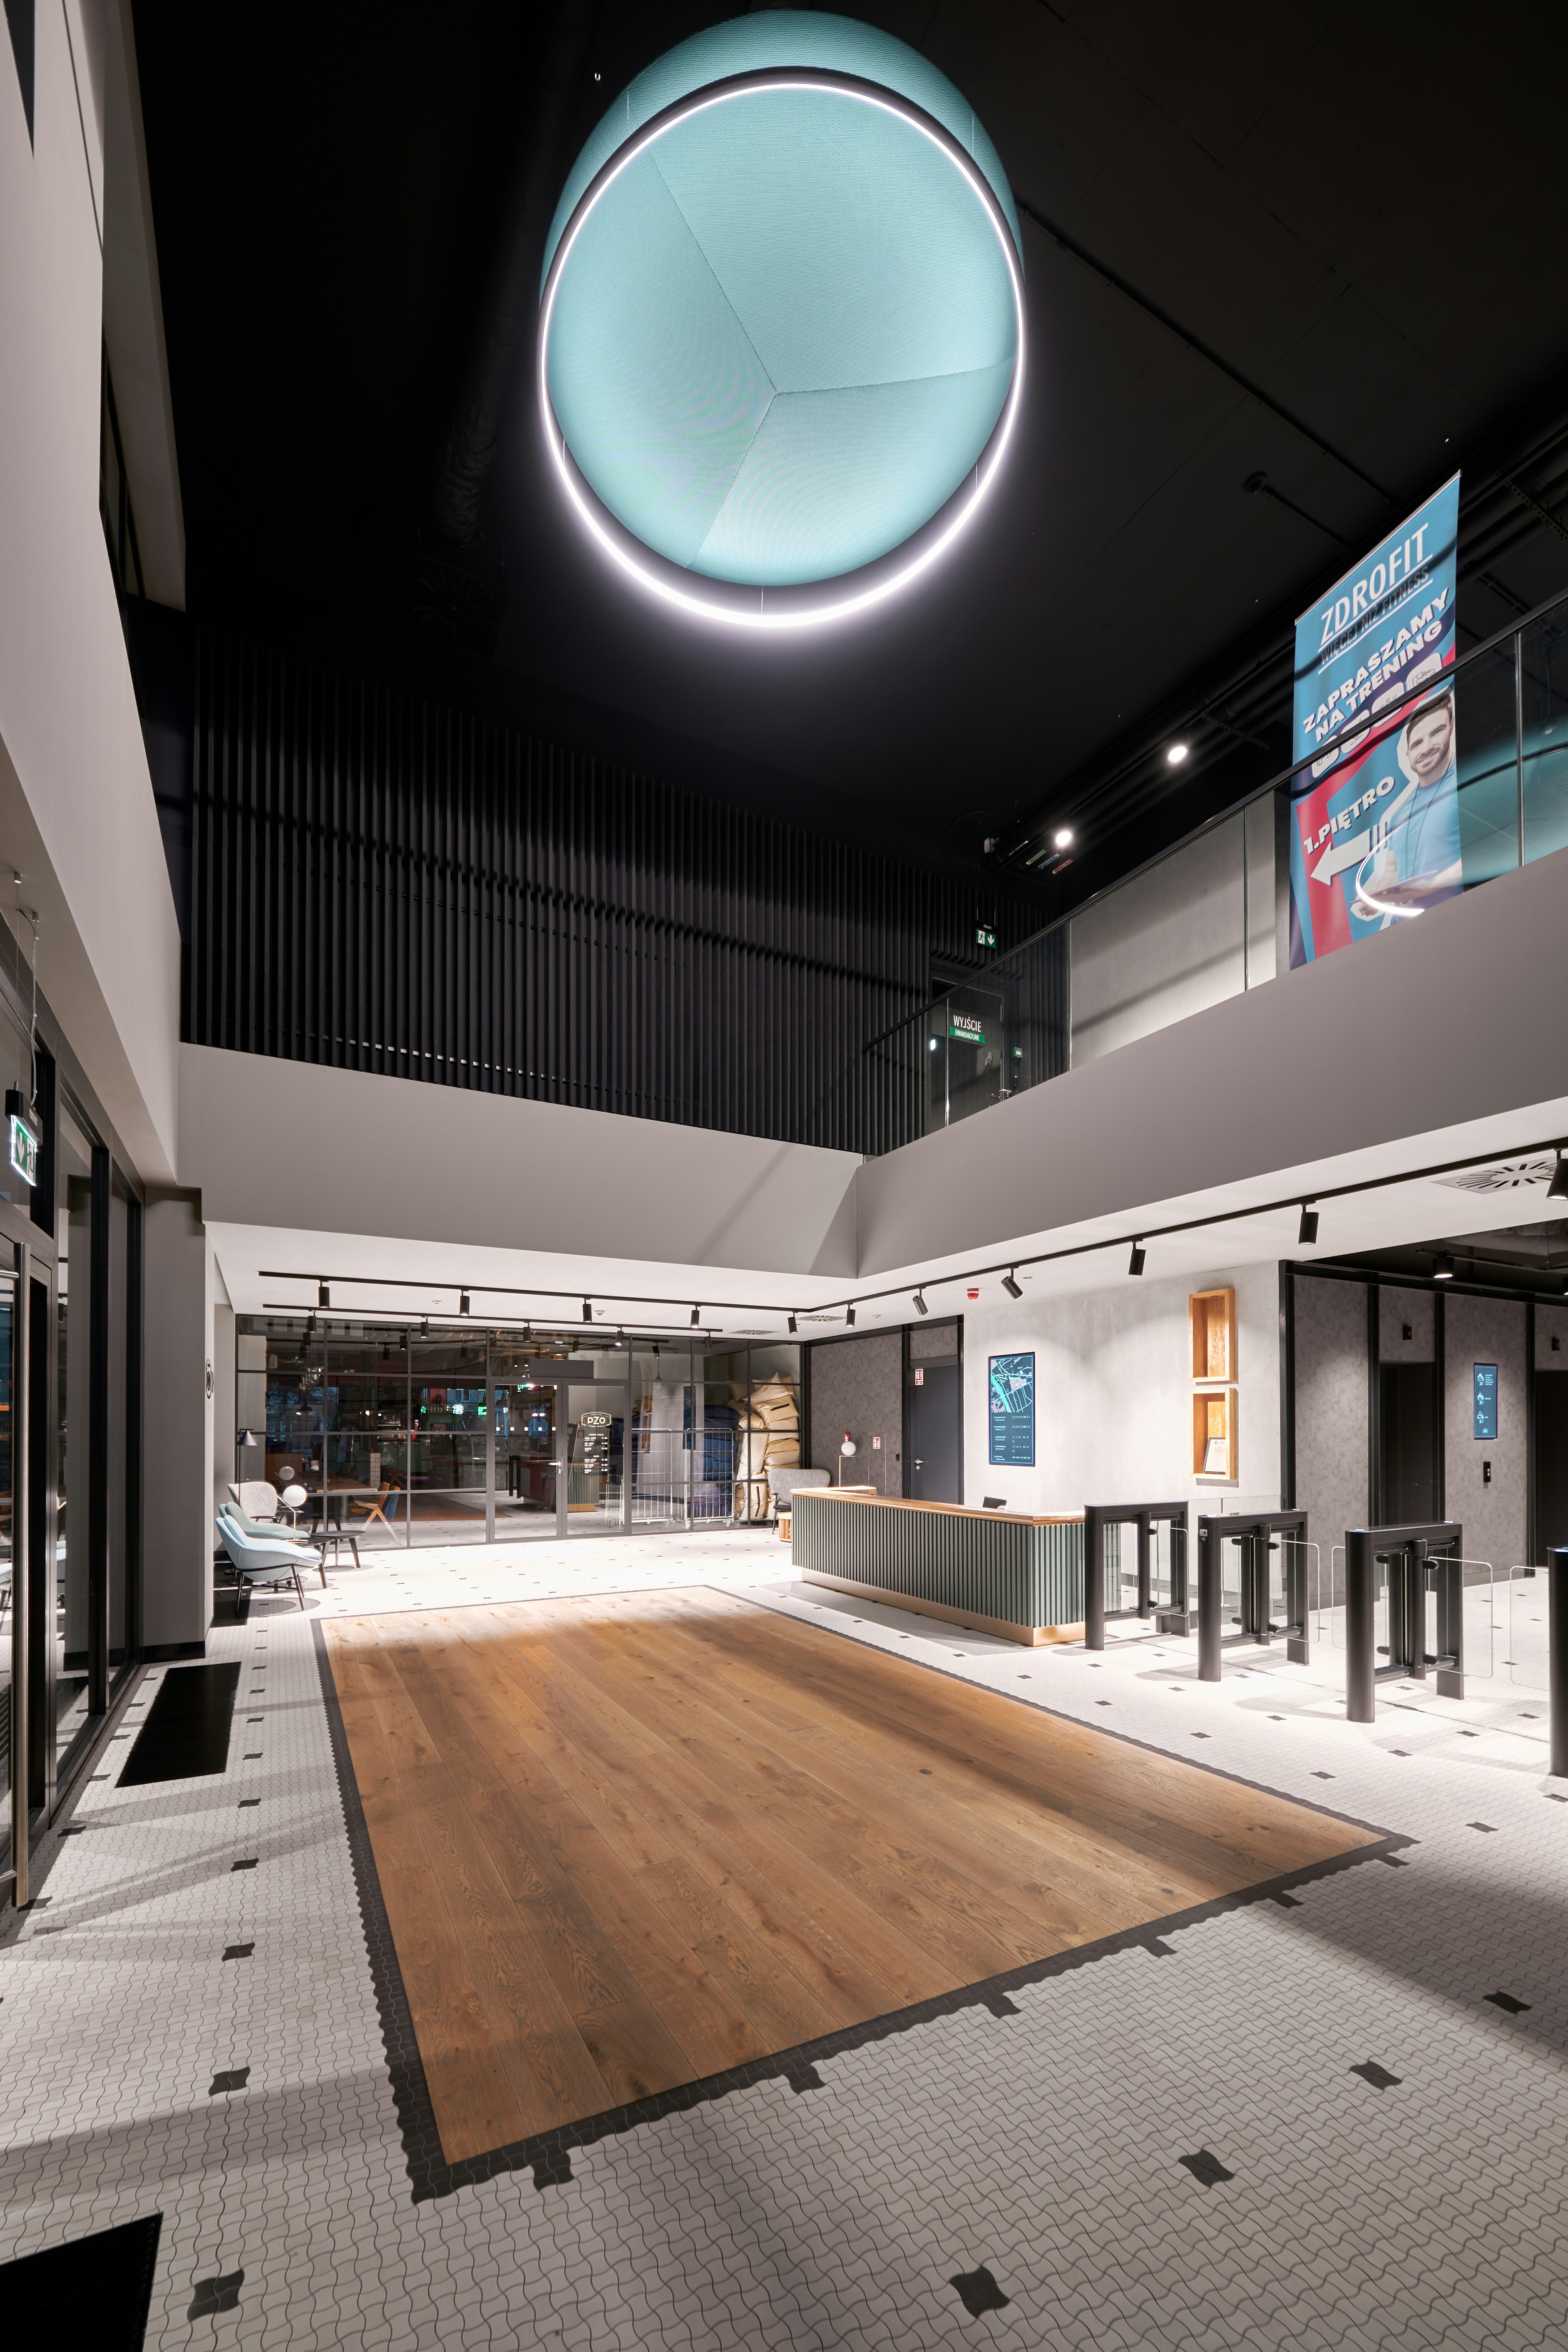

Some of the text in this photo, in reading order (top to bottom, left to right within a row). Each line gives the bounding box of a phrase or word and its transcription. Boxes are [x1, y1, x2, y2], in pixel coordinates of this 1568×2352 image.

[1321, 522, 1429, 646] ZDROFIT
[1321, 566, 1429, 665] WIĘCEJ NIŻ FITNESS
[1303, 588, 1449, 733] ZAPRASZAMY
[1316, 621, 1443, 743] NA TRENING
[1304, 776, 1396, 854] 1.PIĘTRO
[953, 1015, 982, 1033] WYJŚCIE
[955, 1029, 979, 1041] EWAKUACYJNE
[587, 1416, 606, 1425] PZO
